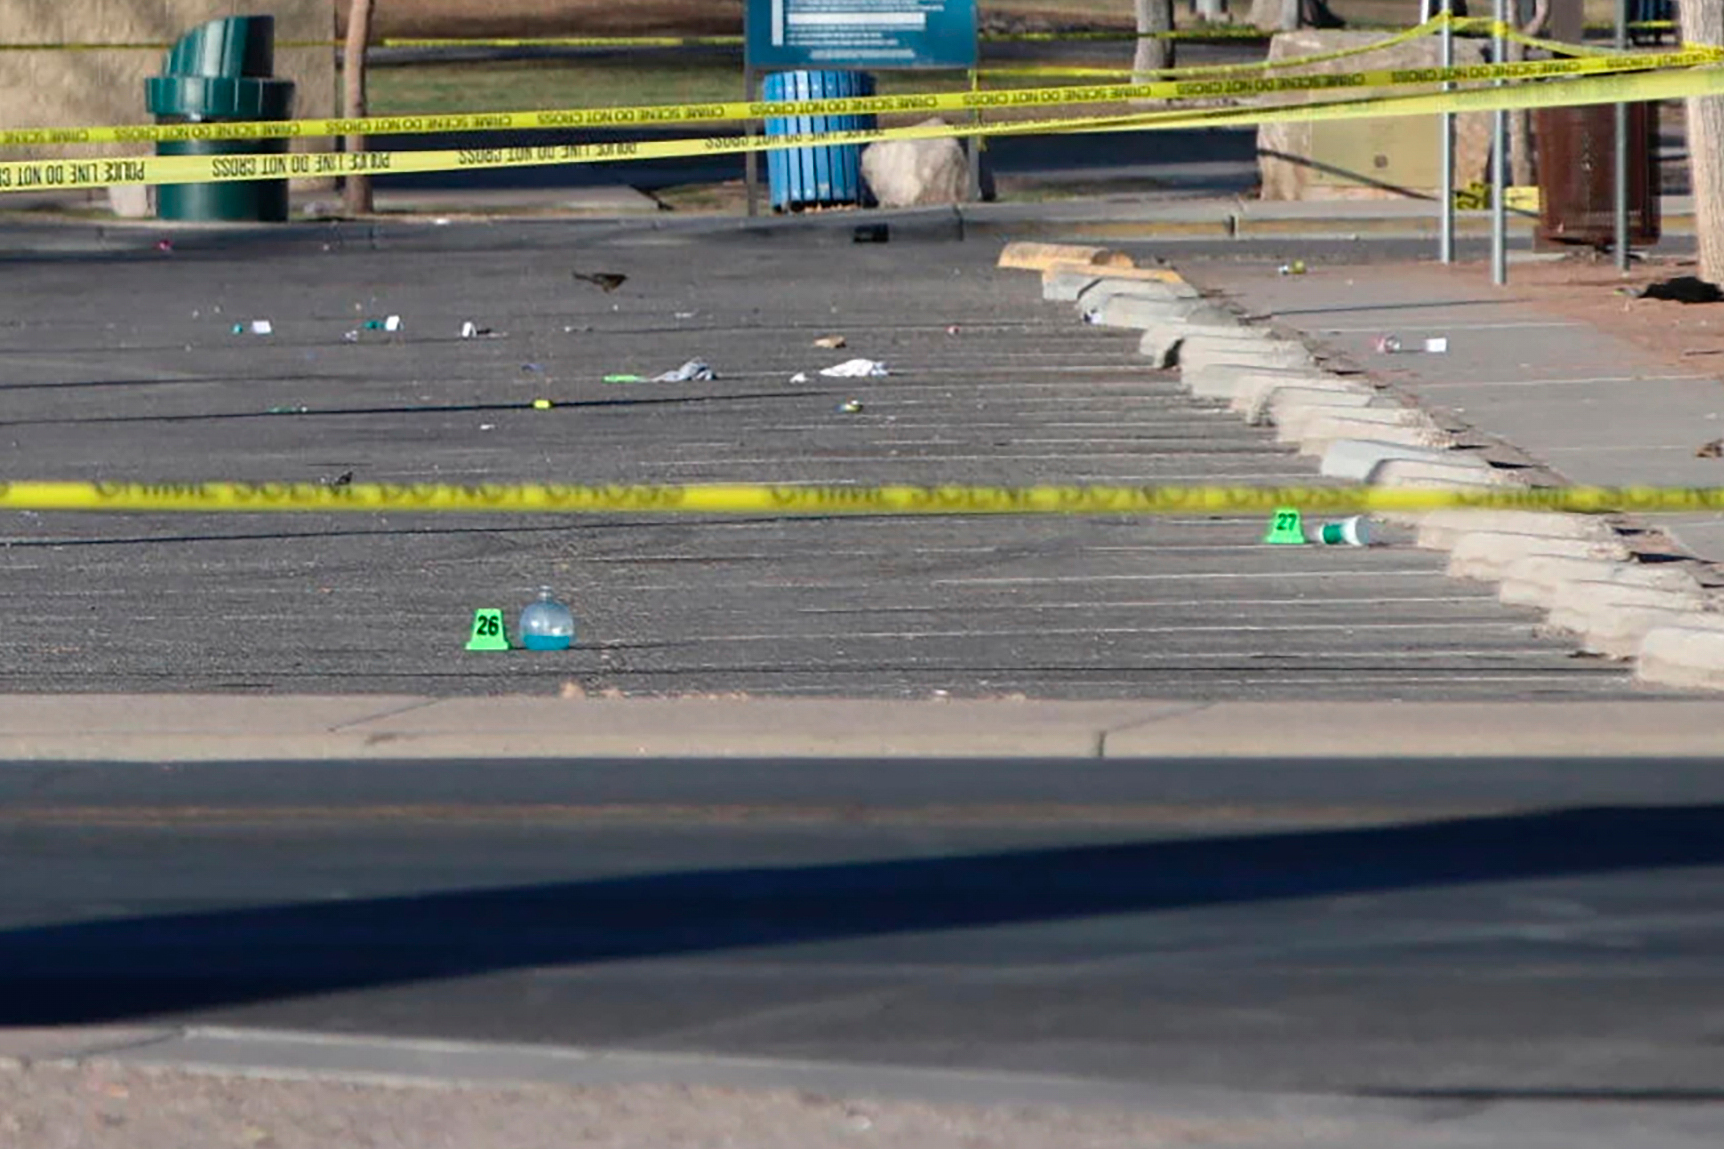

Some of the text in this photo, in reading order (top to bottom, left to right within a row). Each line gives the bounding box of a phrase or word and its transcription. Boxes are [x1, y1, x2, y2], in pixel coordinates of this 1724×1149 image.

[963, 85, 1151, 105] CRIME SCENE DO NOT CROSS
[538, 106, 725, 124] CRIME SCENE DO NOT CROSS
[749, 96, 938, 115] CRIME SCENE DO NOT CROSS
[113, 123, 300, 142] CRIME SCENE DO NOT CROSS
[325, 115, 512, 133] CRIME SCENE DO NOT CROSS
[70, 163, 98, 183] LINE
[105, 161, 145, 181] POLICE
[212, 152, 390, 177] POLICE LINE DO NOT CROSS
[16, 166, 41, 186] NOT
[46, 165, 64, 184] DO
[1277, 513, 1297, 531] 27
[477, 615, 499, 636] 26
